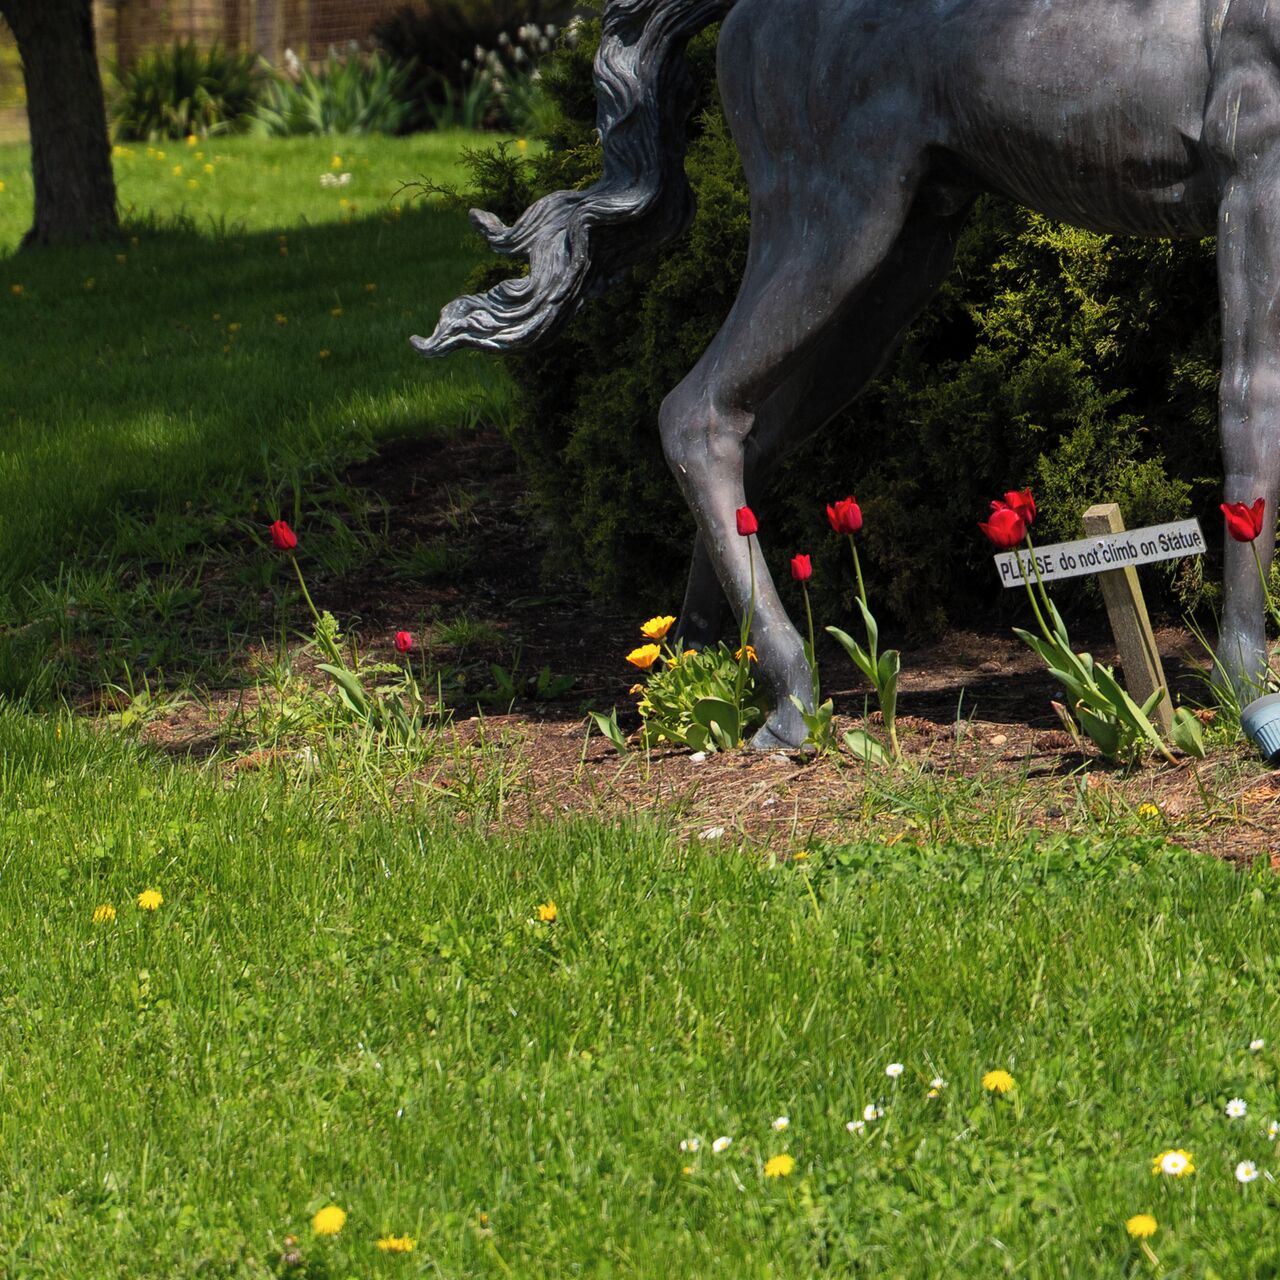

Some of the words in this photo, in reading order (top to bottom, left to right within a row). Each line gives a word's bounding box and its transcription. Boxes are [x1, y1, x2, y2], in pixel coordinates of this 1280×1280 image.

[1059, 552, 1077, 571] do
[1078, 549, 1101, 569] not
[1102, 539, 1138, 564] climb
[1140, 541, 1158, 558] on
[1158, 530, 1202, 553] Statue
